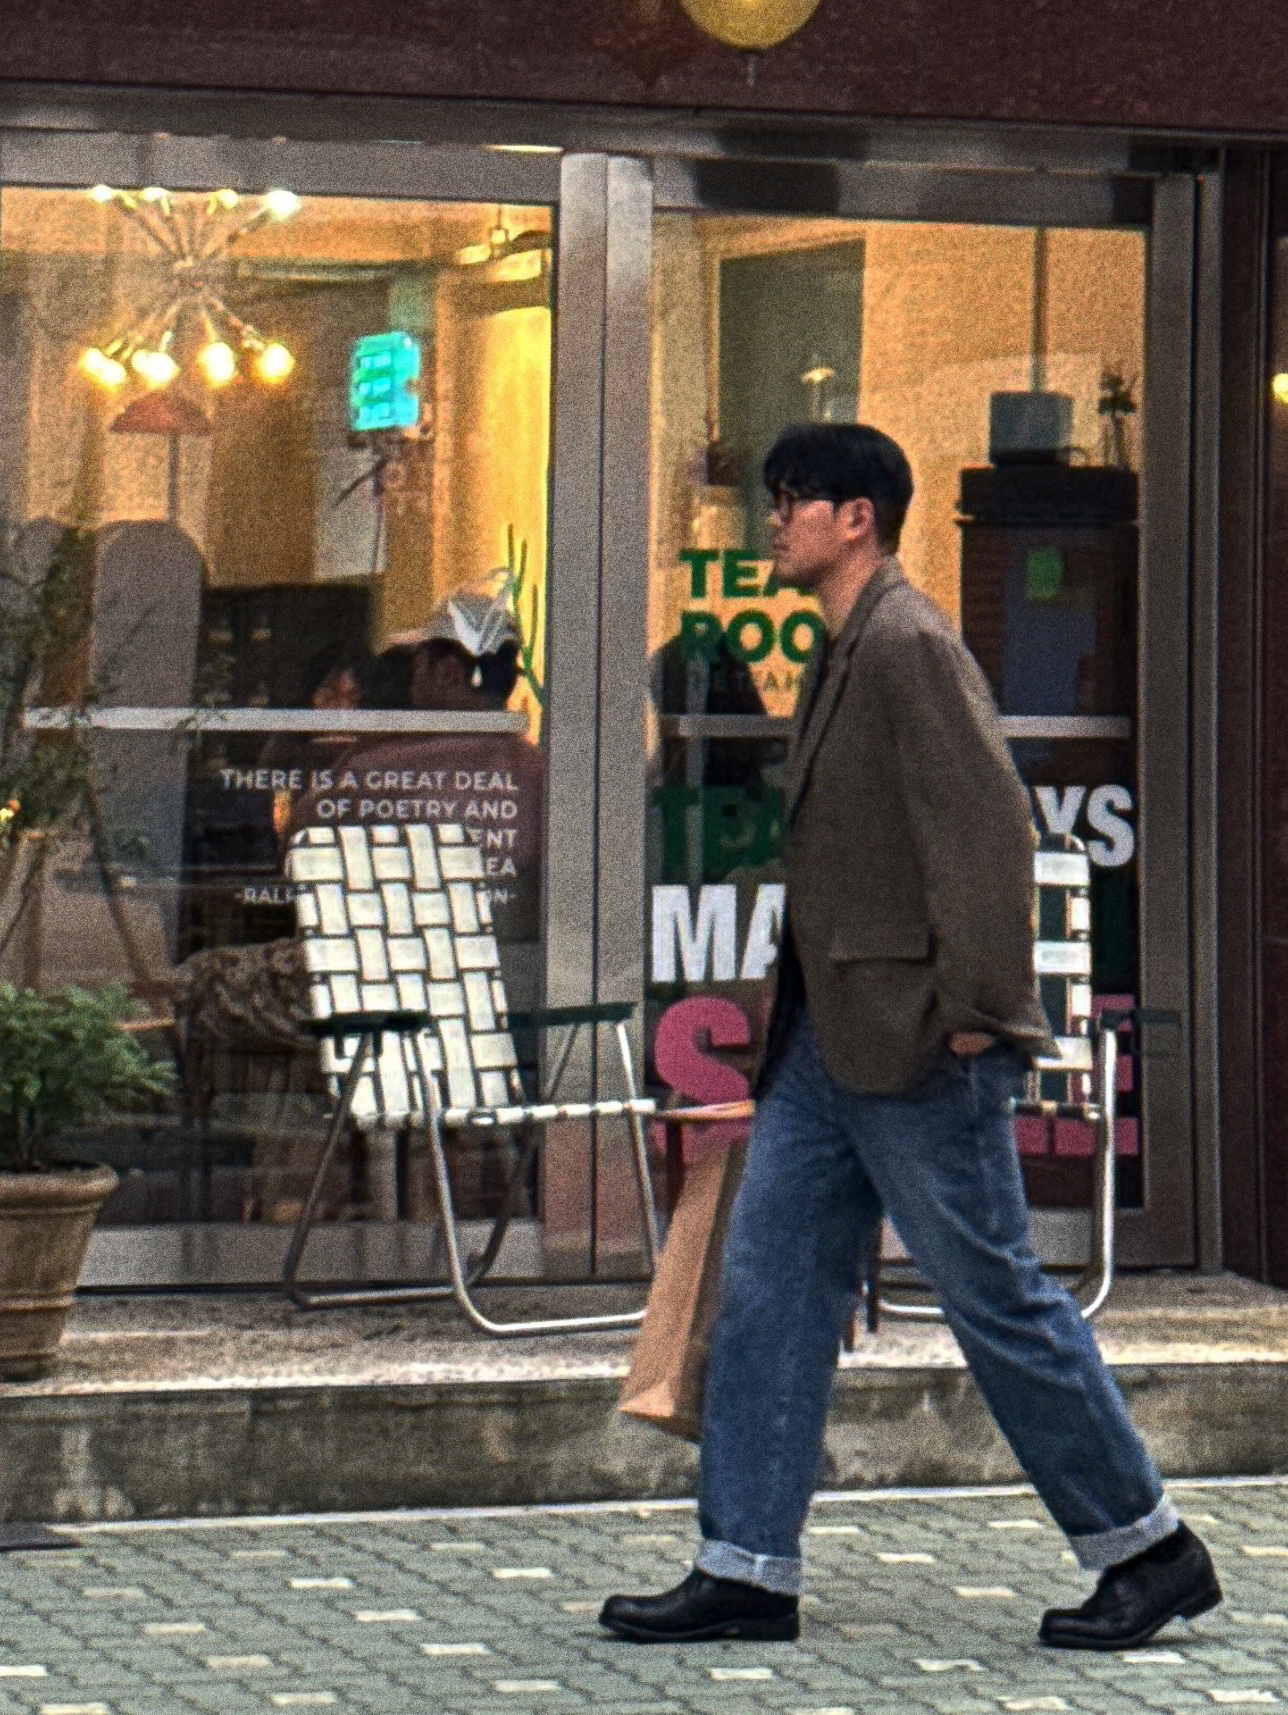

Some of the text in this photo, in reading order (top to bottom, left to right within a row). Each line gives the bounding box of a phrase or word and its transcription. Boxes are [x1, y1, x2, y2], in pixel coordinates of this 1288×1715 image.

[220, 769, 519, 792] THERE IS A GREAT DEAL
[316, 800, 518, 820] OF POETRY AND
[1034, 784, 1134, 868] YS
[486, 856, 518, 876] EA
